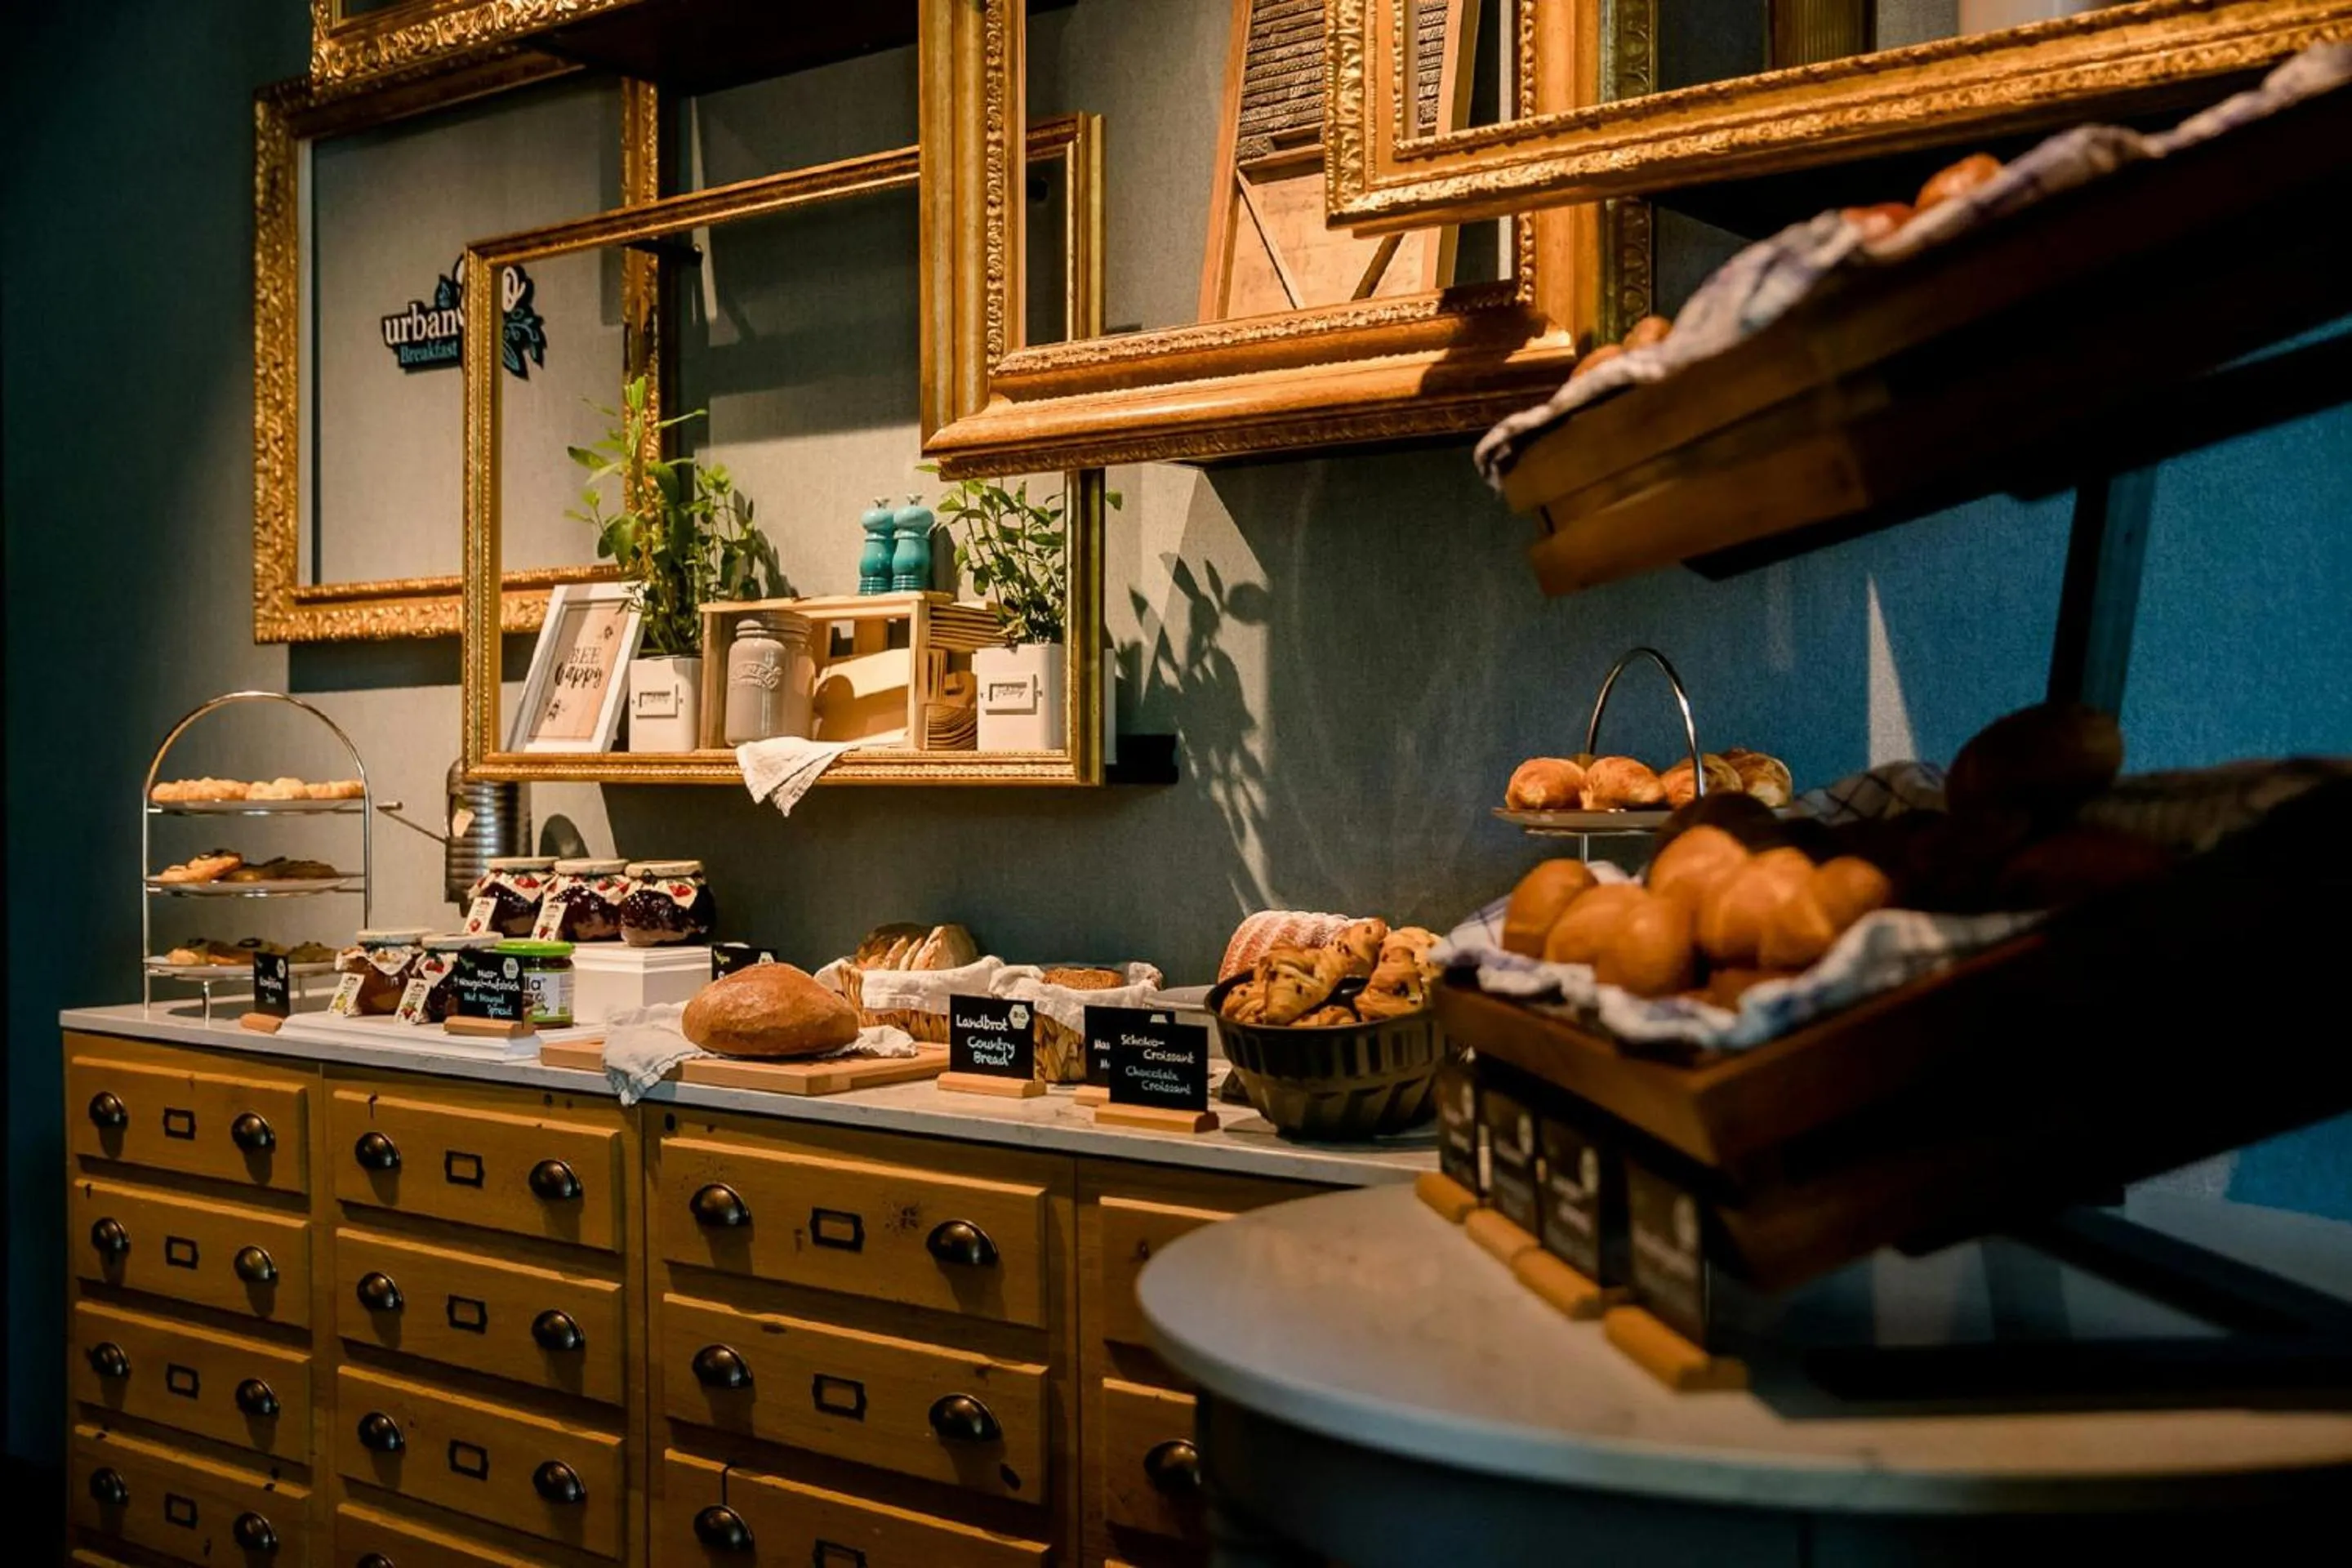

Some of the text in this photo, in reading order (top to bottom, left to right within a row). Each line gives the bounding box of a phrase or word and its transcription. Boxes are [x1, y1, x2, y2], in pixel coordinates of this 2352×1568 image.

[384, 303, 459, 344] urban
[400, 341, 458, 363] Breakfast
[956, 1013, 1009, 1031] Landbrot
[966, 1035, 1015, 1060] Country
[973, 1050, 1009, 1067] Bread
[1143, 1048, 1196, 1065] Croissant
[1125, 1065, 1179, 1081] Chocolate
[1141, 1080, 1192, 1095] Croissant
